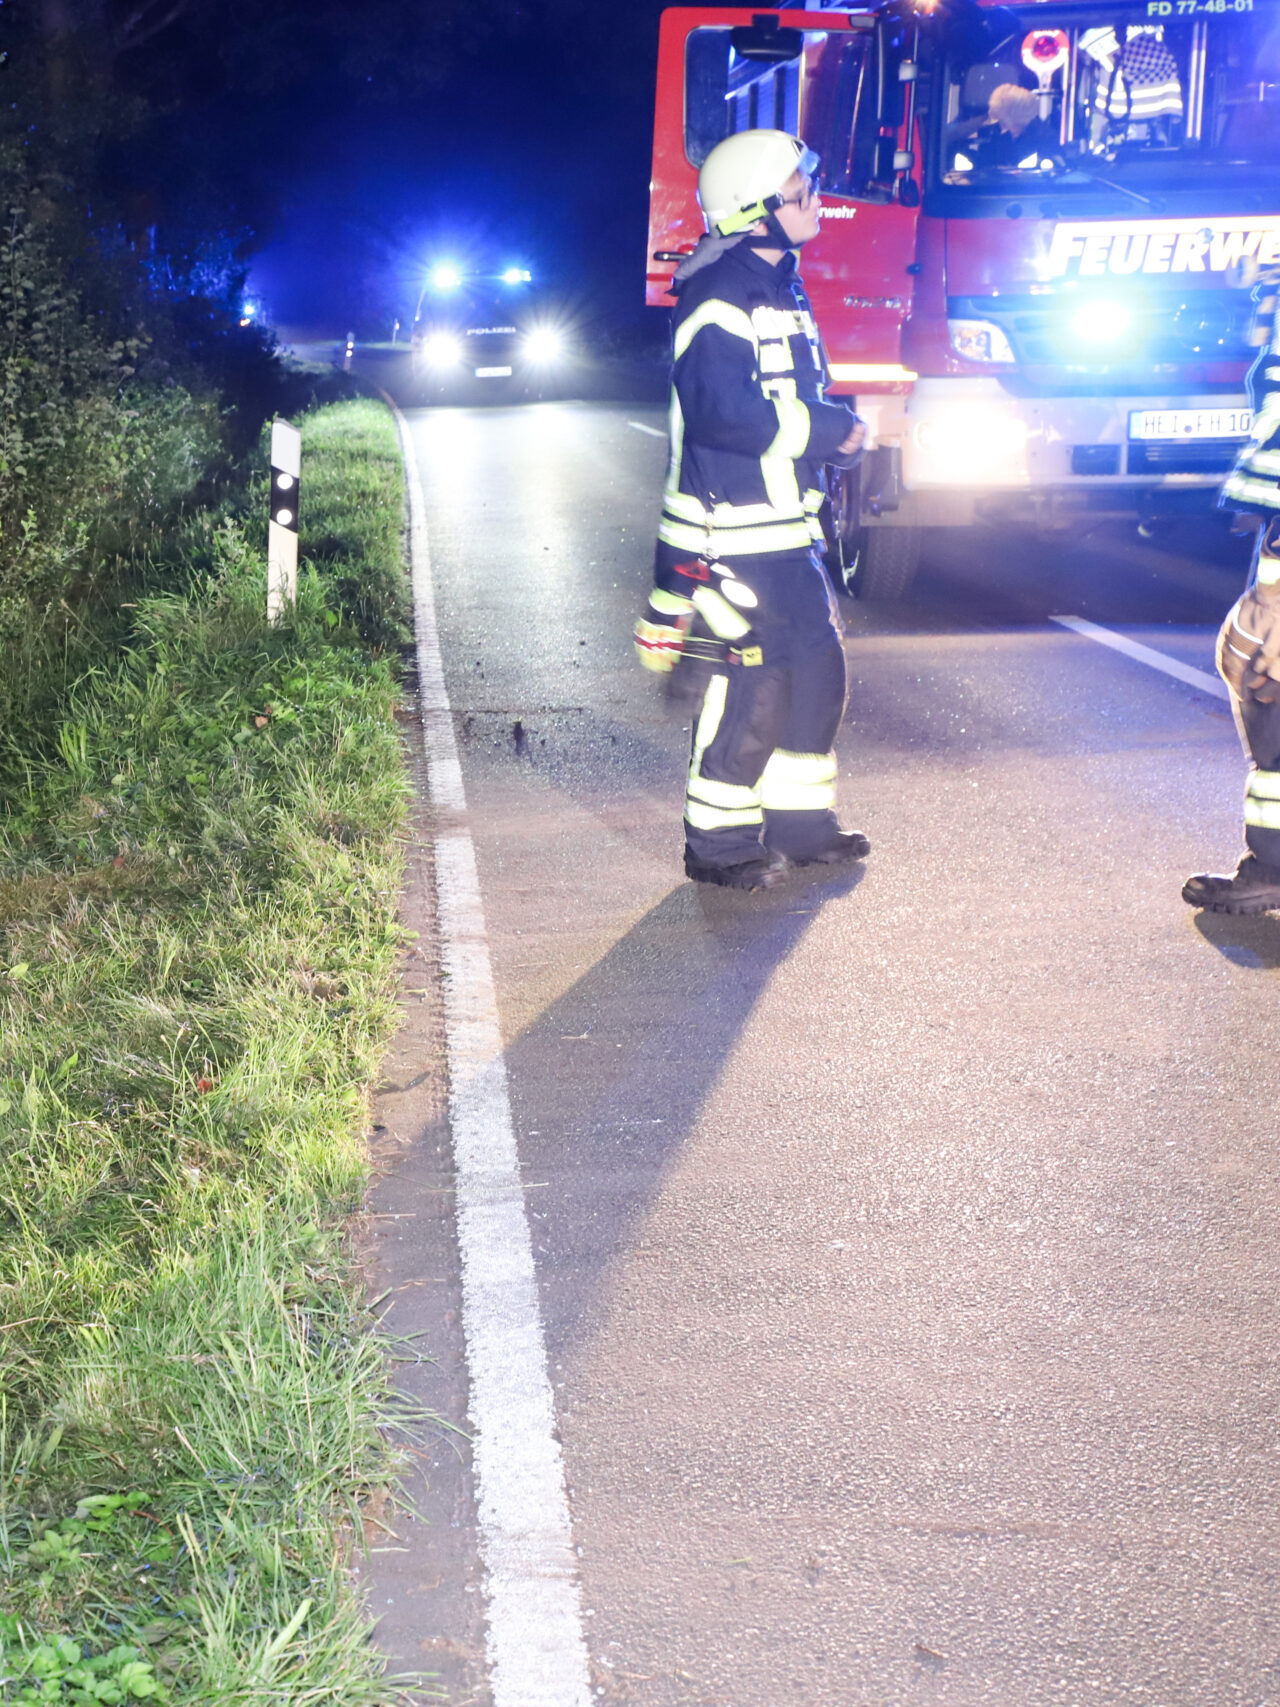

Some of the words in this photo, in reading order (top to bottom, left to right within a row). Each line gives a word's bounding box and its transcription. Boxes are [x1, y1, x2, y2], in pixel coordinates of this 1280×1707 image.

[1147, 1, 1172, 16] FD
[1176, 0, 1254, 15] 77-48-01
[818, 204, 856, 219] rwehr
[466, 326, 516, 336] POLIZEI
[1144, 415, 1178, 433] HEI
